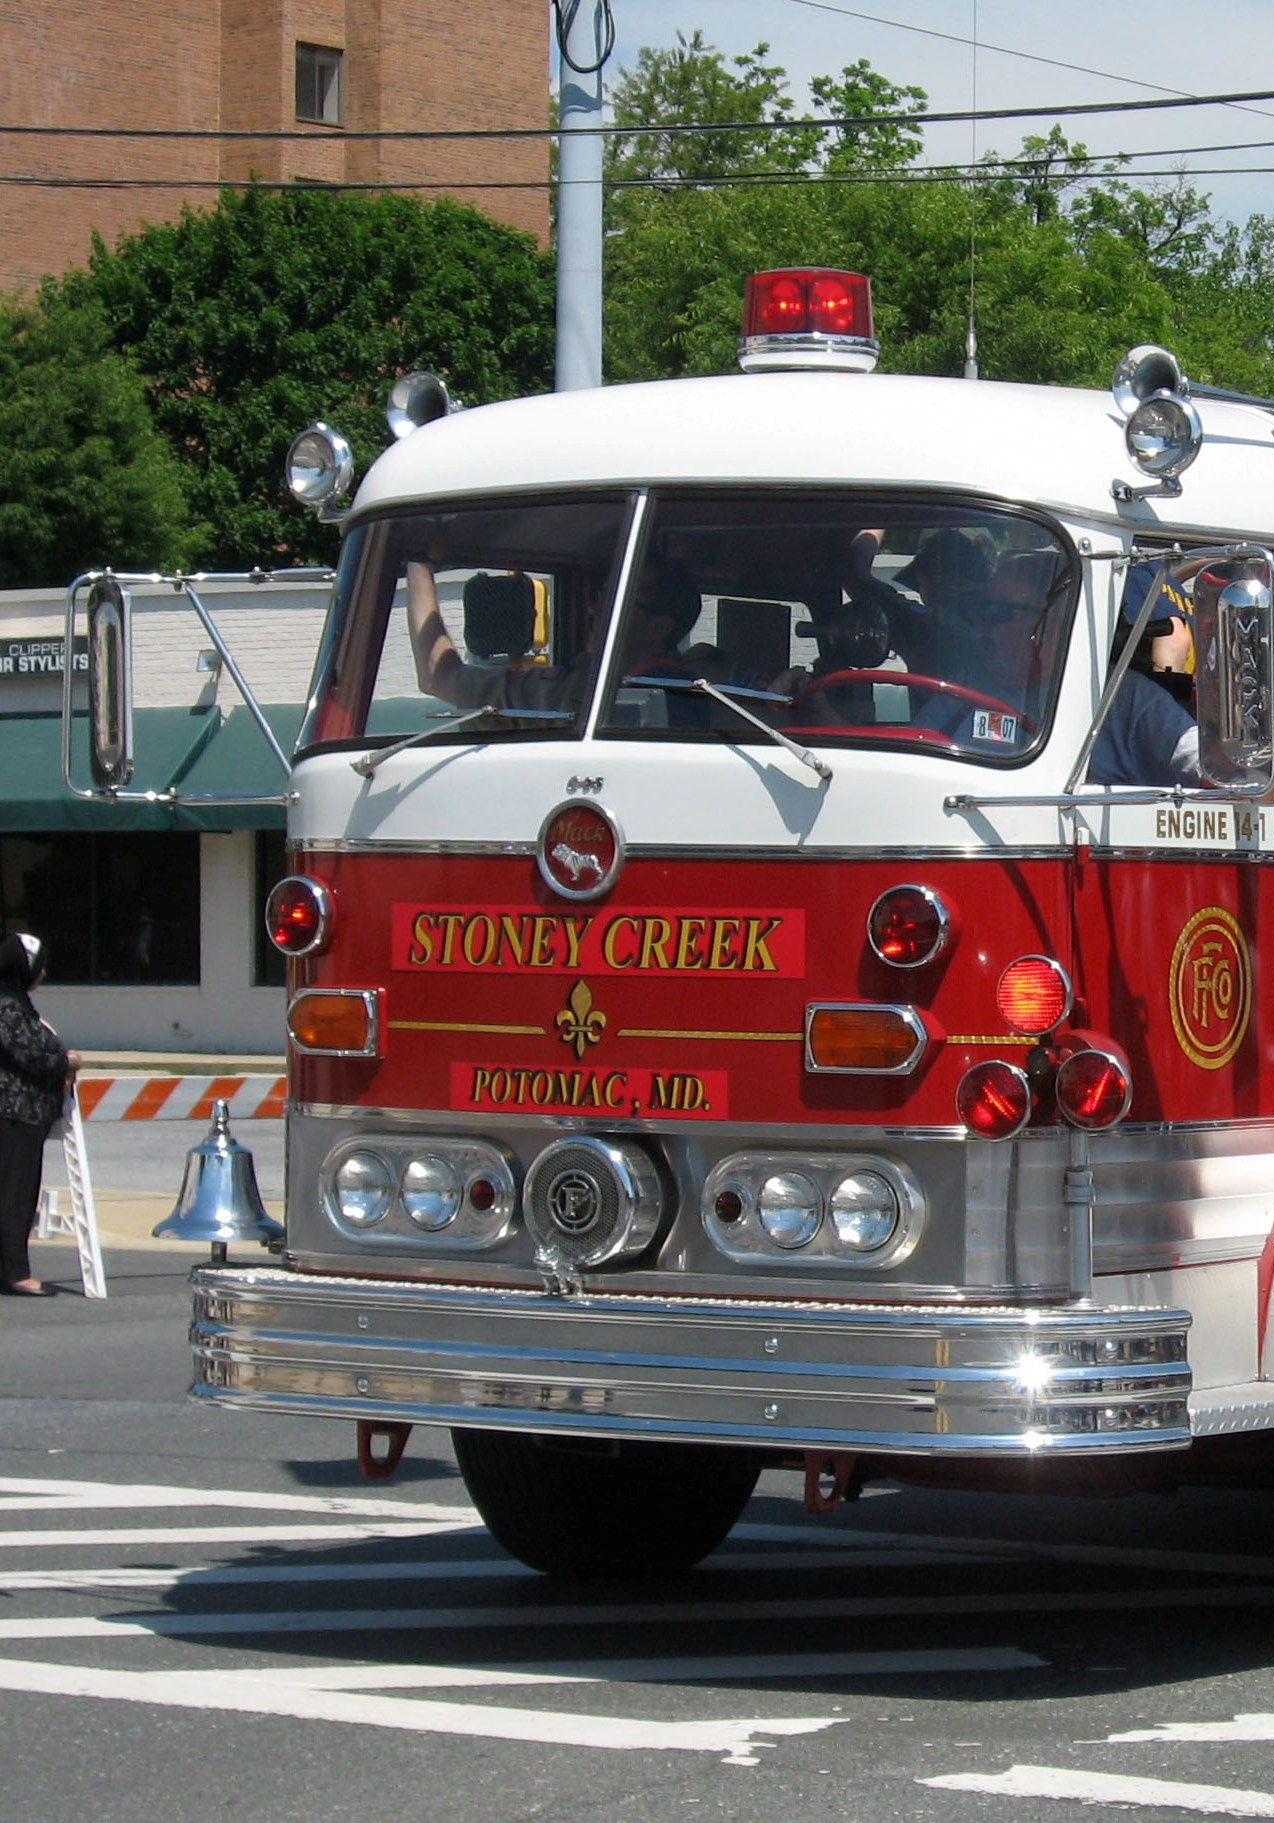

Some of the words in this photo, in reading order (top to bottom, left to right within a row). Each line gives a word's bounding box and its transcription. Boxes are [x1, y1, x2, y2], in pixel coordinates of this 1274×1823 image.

[1002, 717, 1014, 738] 07
[553, 820, 605, 841] Mack
[1156, 809, 1228, 840] ENGINE
[409, 912, 593, 967] STONEY
[603, 916, 783, 972] CREEK
[650, 1074, 712, 1112] MD.
